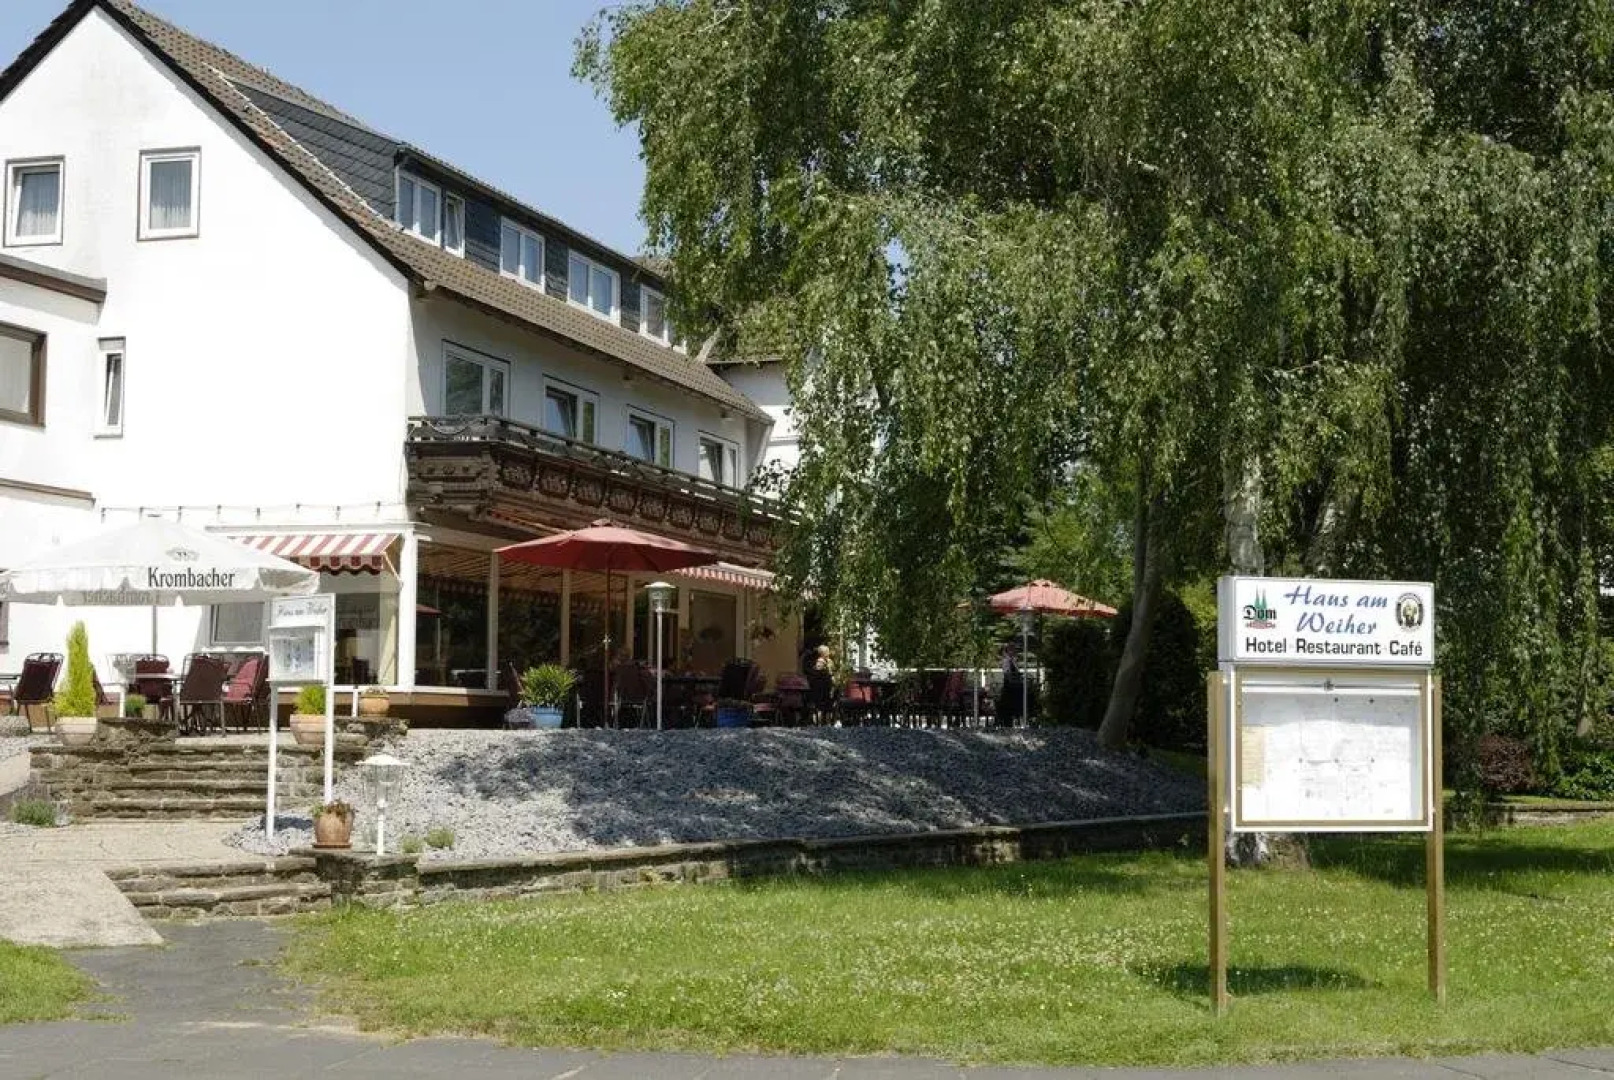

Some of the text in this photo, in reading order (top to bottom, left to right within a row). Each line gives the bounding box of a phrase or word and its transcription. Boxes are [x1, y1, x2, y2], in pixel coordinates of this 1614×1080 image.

[148, 567, 235, 588] Krombacher
[1283, 585, 1349, 608] Haus
[1356, 594, 1388, 608] am
[1242, 604, 1278, 620] Dom
[1296, 612, 1377, 635] Weiher
[1245, 637, 1423, 657] Hotel Restaurant Café
